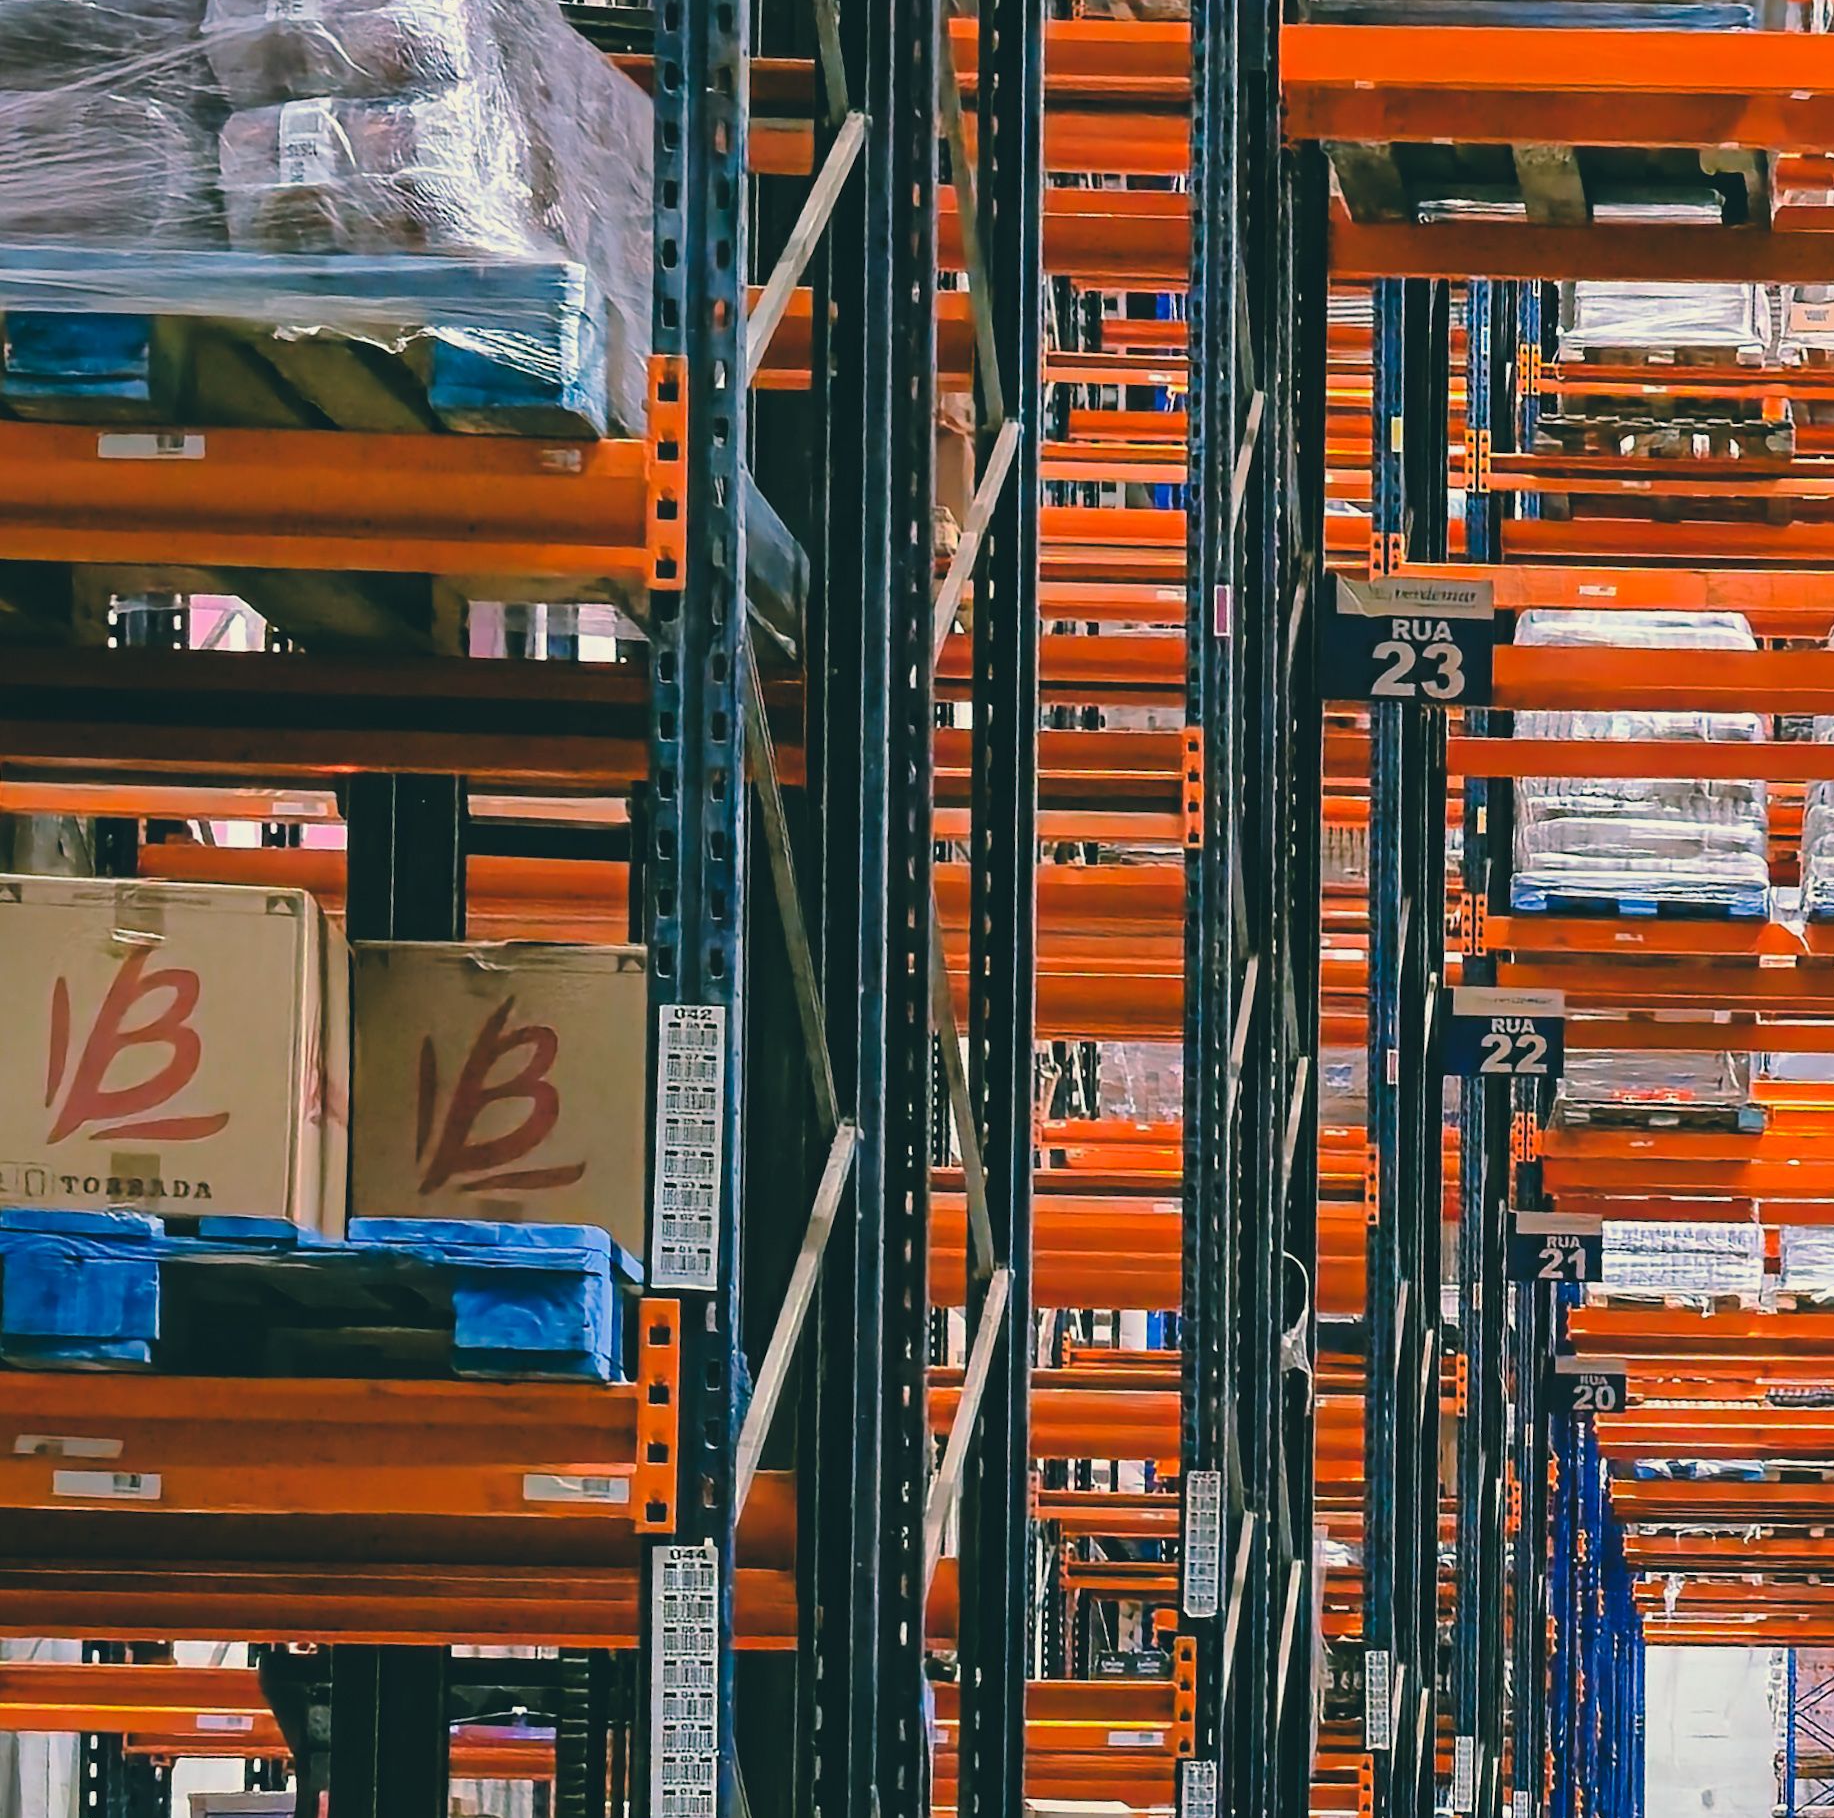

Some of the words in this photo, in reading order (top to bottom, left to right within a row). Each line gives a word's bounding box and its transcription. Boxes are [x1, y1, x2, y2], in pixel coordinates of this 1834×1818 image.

[1391, 619, 1454, 642] RUA
[1370, 640, 1466, 700] 23
[674, 1008, 713, 1020] 042
[1491, 1018, 1536, 1034] RUA
[1479, 1033, 1548, 1074] 22
[1546, 1235, 1582, 1249] RUA
[1538, 1248, 1587, 1280] 21
[1572, 1385, 1616, 1411] 20
[669, 1548, 708, 1560] 044
